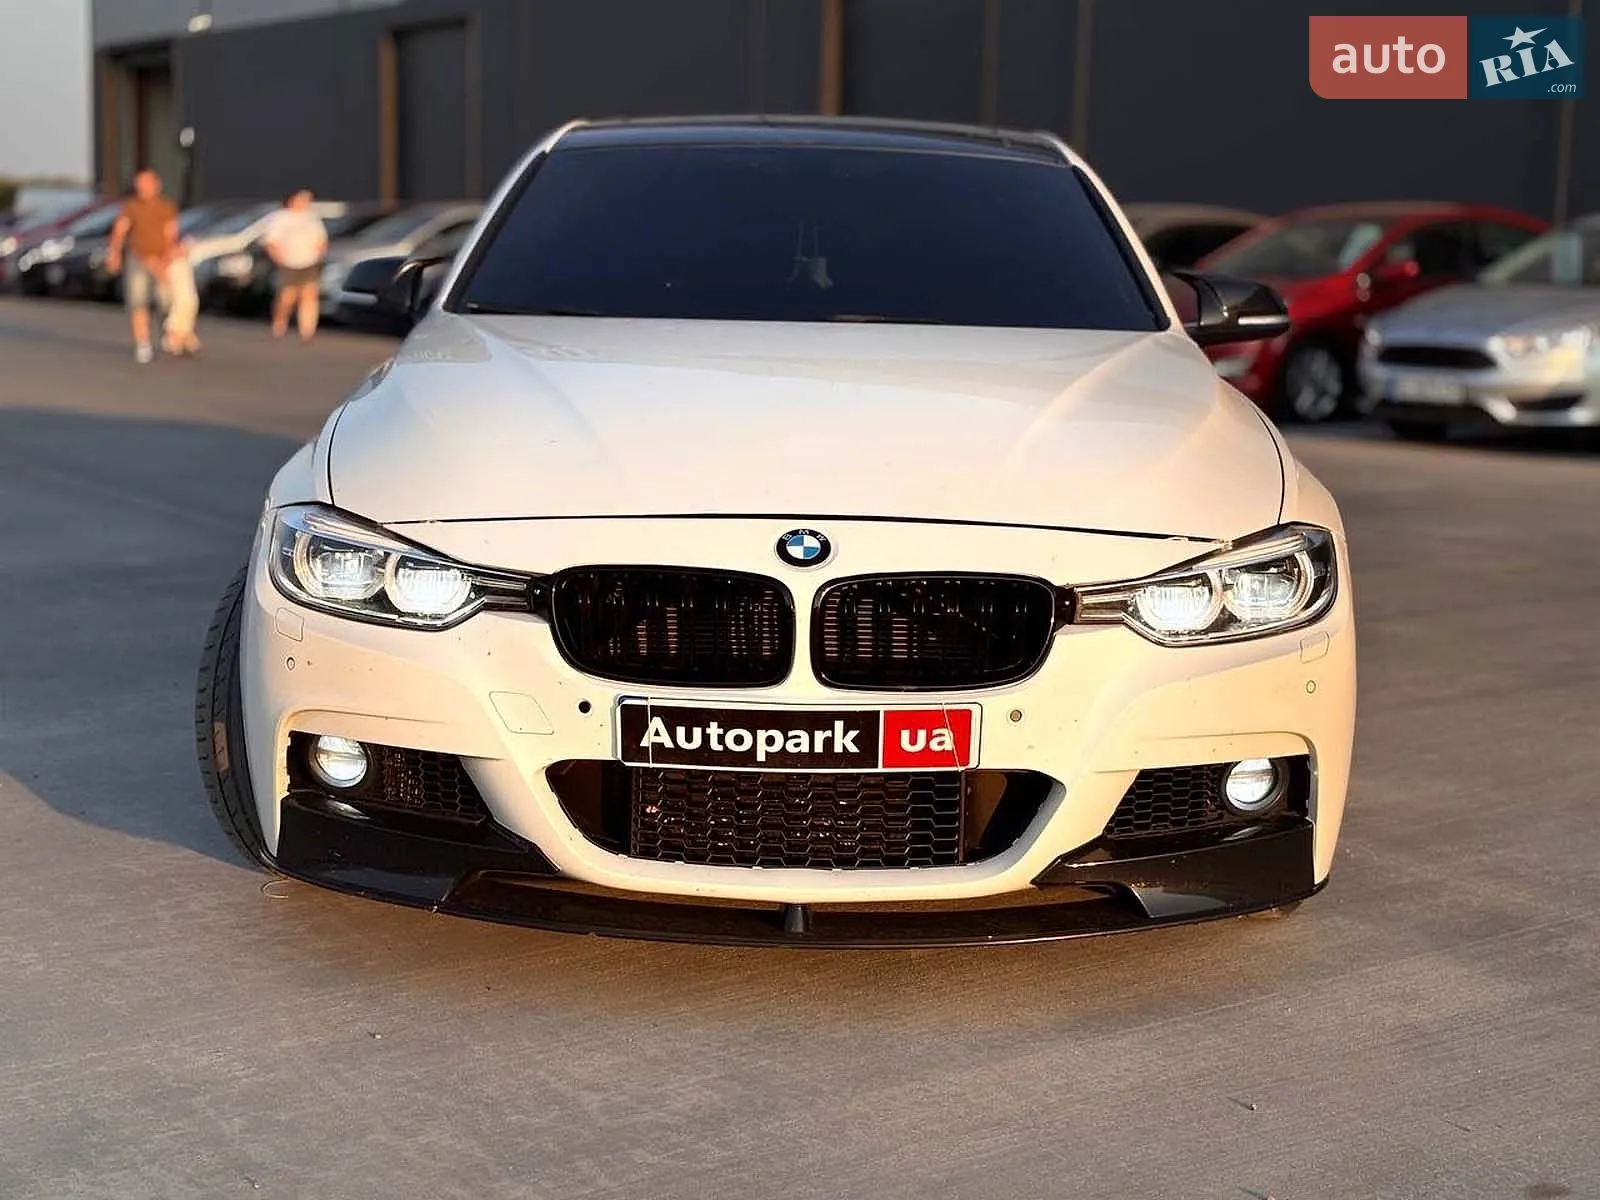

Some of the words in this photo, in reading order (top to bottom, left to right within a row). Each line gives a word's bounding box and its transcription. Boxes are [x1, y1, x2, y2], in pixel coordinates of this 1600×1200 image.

[781, 529, 827, 541] BMW
[639, 716, 860, 762] Autopark
[900, 726, 954, 753] ua
